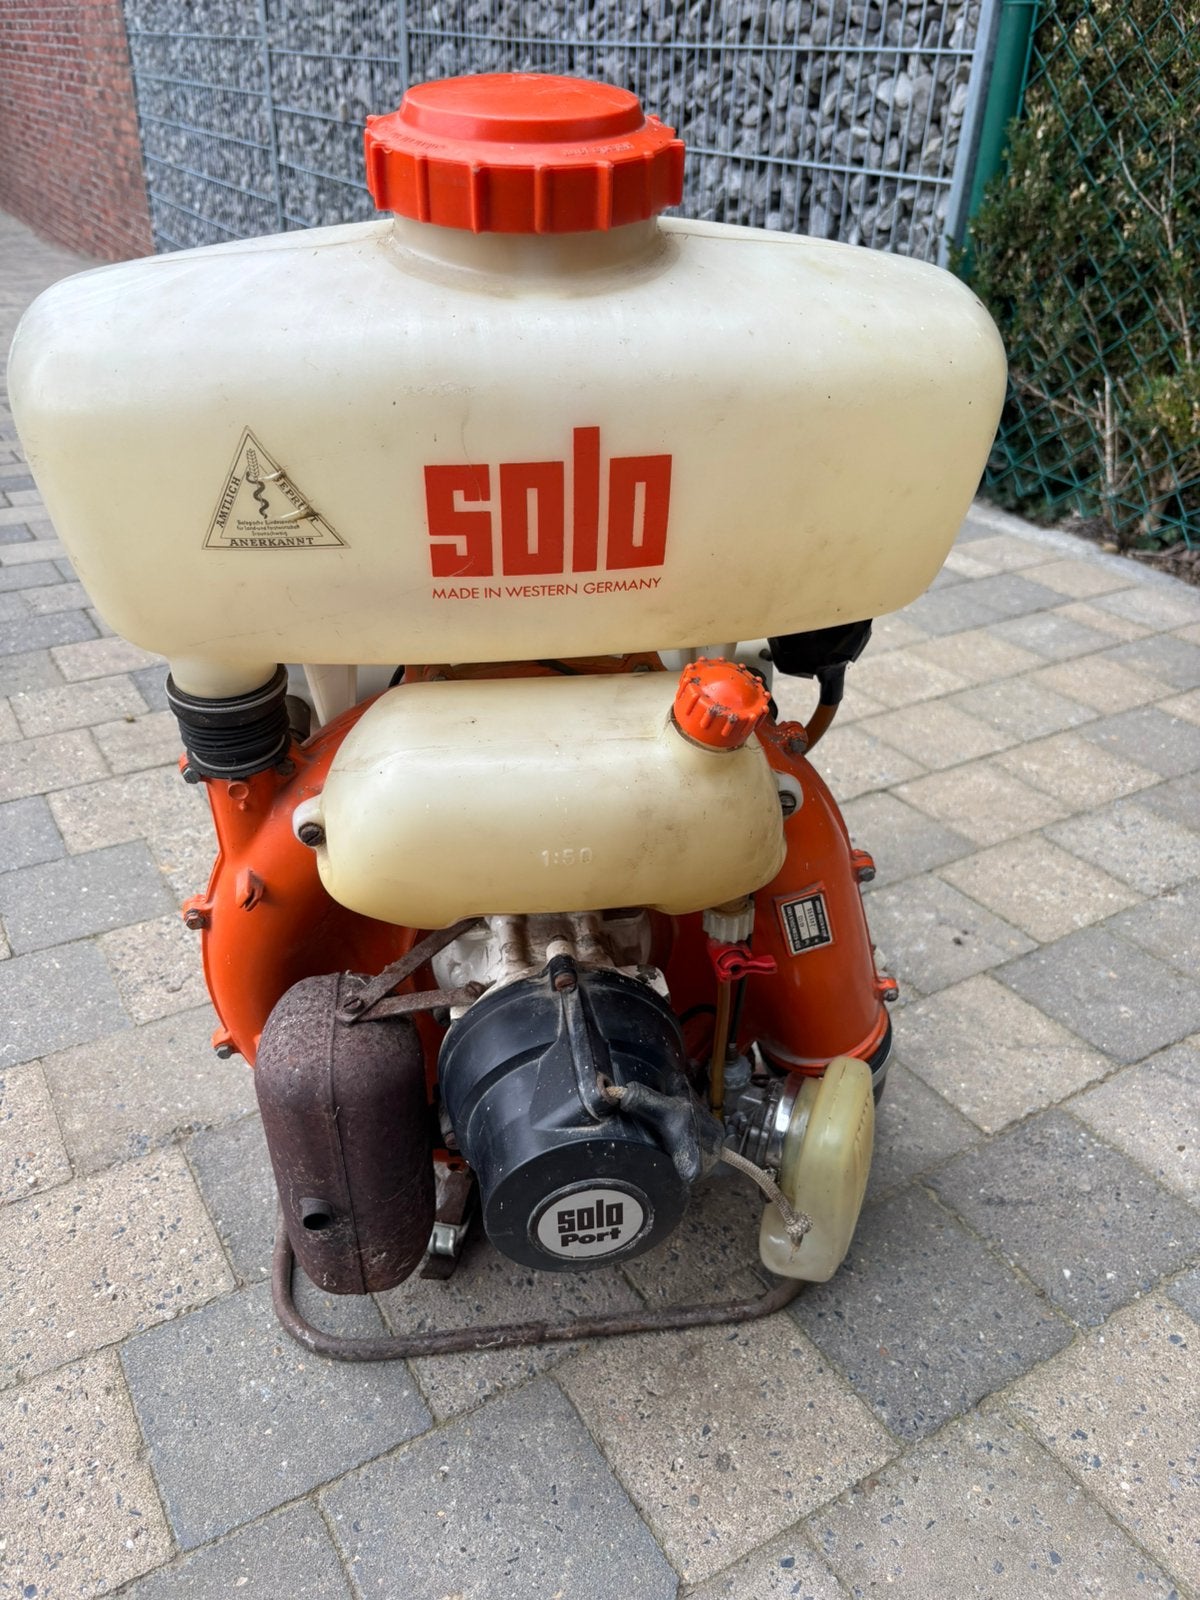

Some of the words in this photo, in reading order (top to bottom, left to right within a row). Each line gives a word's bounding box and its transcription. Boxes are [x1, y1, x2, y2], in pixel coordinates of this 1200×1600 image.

[216, 476, 241, 528] AMTLICH
[424, 426, 672, 577] solo
[230, 537, 314, 547] ANERKANNT
[432, 587, 480, 600] MADE
[484, 587, 501, 599] IN
[505, 582, 578, 598] WESTERN
[583, 577, 662, 595] GERMANY
[557, 1199, 623, 1234] solo
[561, 1227, 621, 1247] Port
